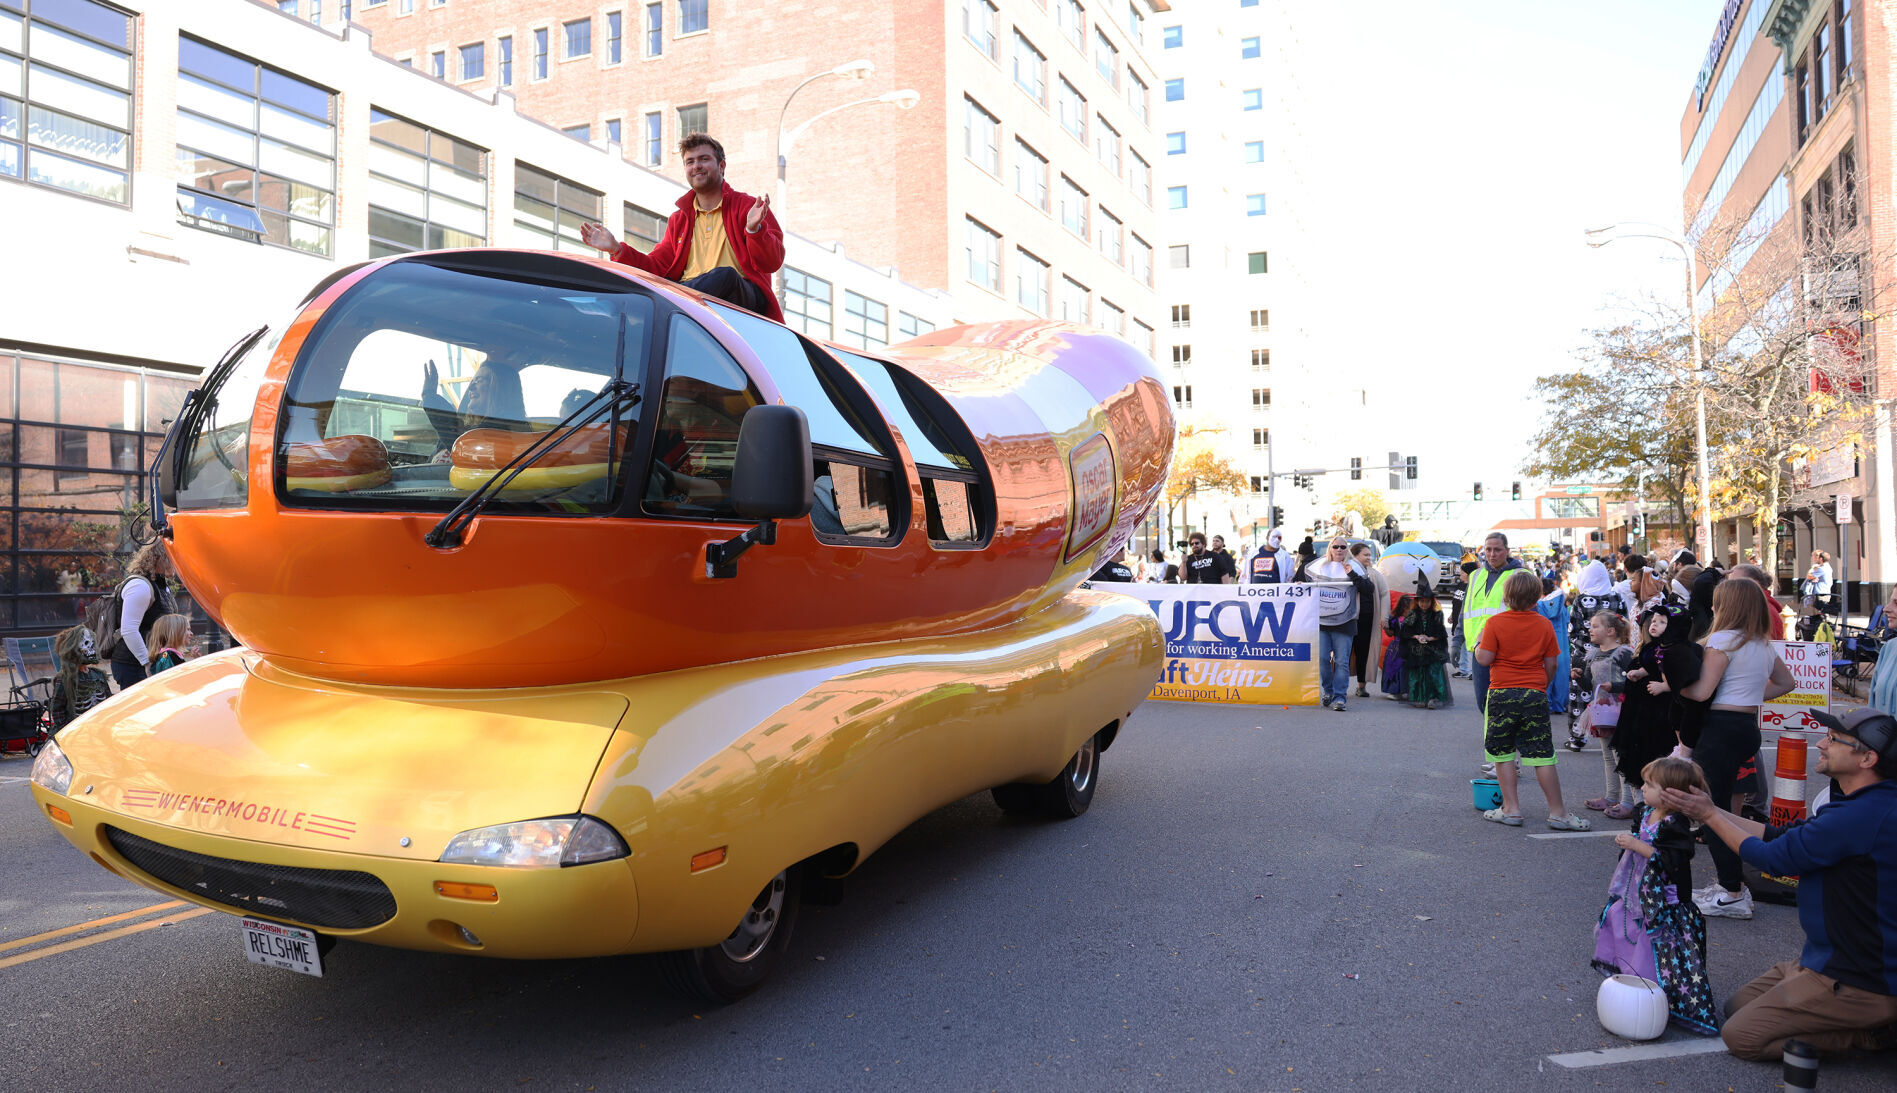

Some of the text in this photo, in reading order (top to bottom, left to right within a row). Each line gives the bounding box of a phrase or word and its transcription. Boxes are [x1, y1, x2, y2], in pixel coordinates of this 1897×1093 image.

[1082, 457, 1108, 499] Oscar
[1079, 486, 1111, 532] Mayer
[1238, 586, 1312, 597] Local 431
[1149, 599, 1296, 643] UFCW
[1166, 641, 1294, 659] for working America
[1785, 648, 1806, 661] NO
[1188, 661, 1273, 688] Heinz
[1794, 679, 1825, 690] BLOCK
[1153, 685, 1241, 701] Davenport, IA
[158, 792, 306, 830] WIENERMOBILE
[242, 919, 282, 935] WISCONSIN
[249, 931, 313, 965] RELSHME
